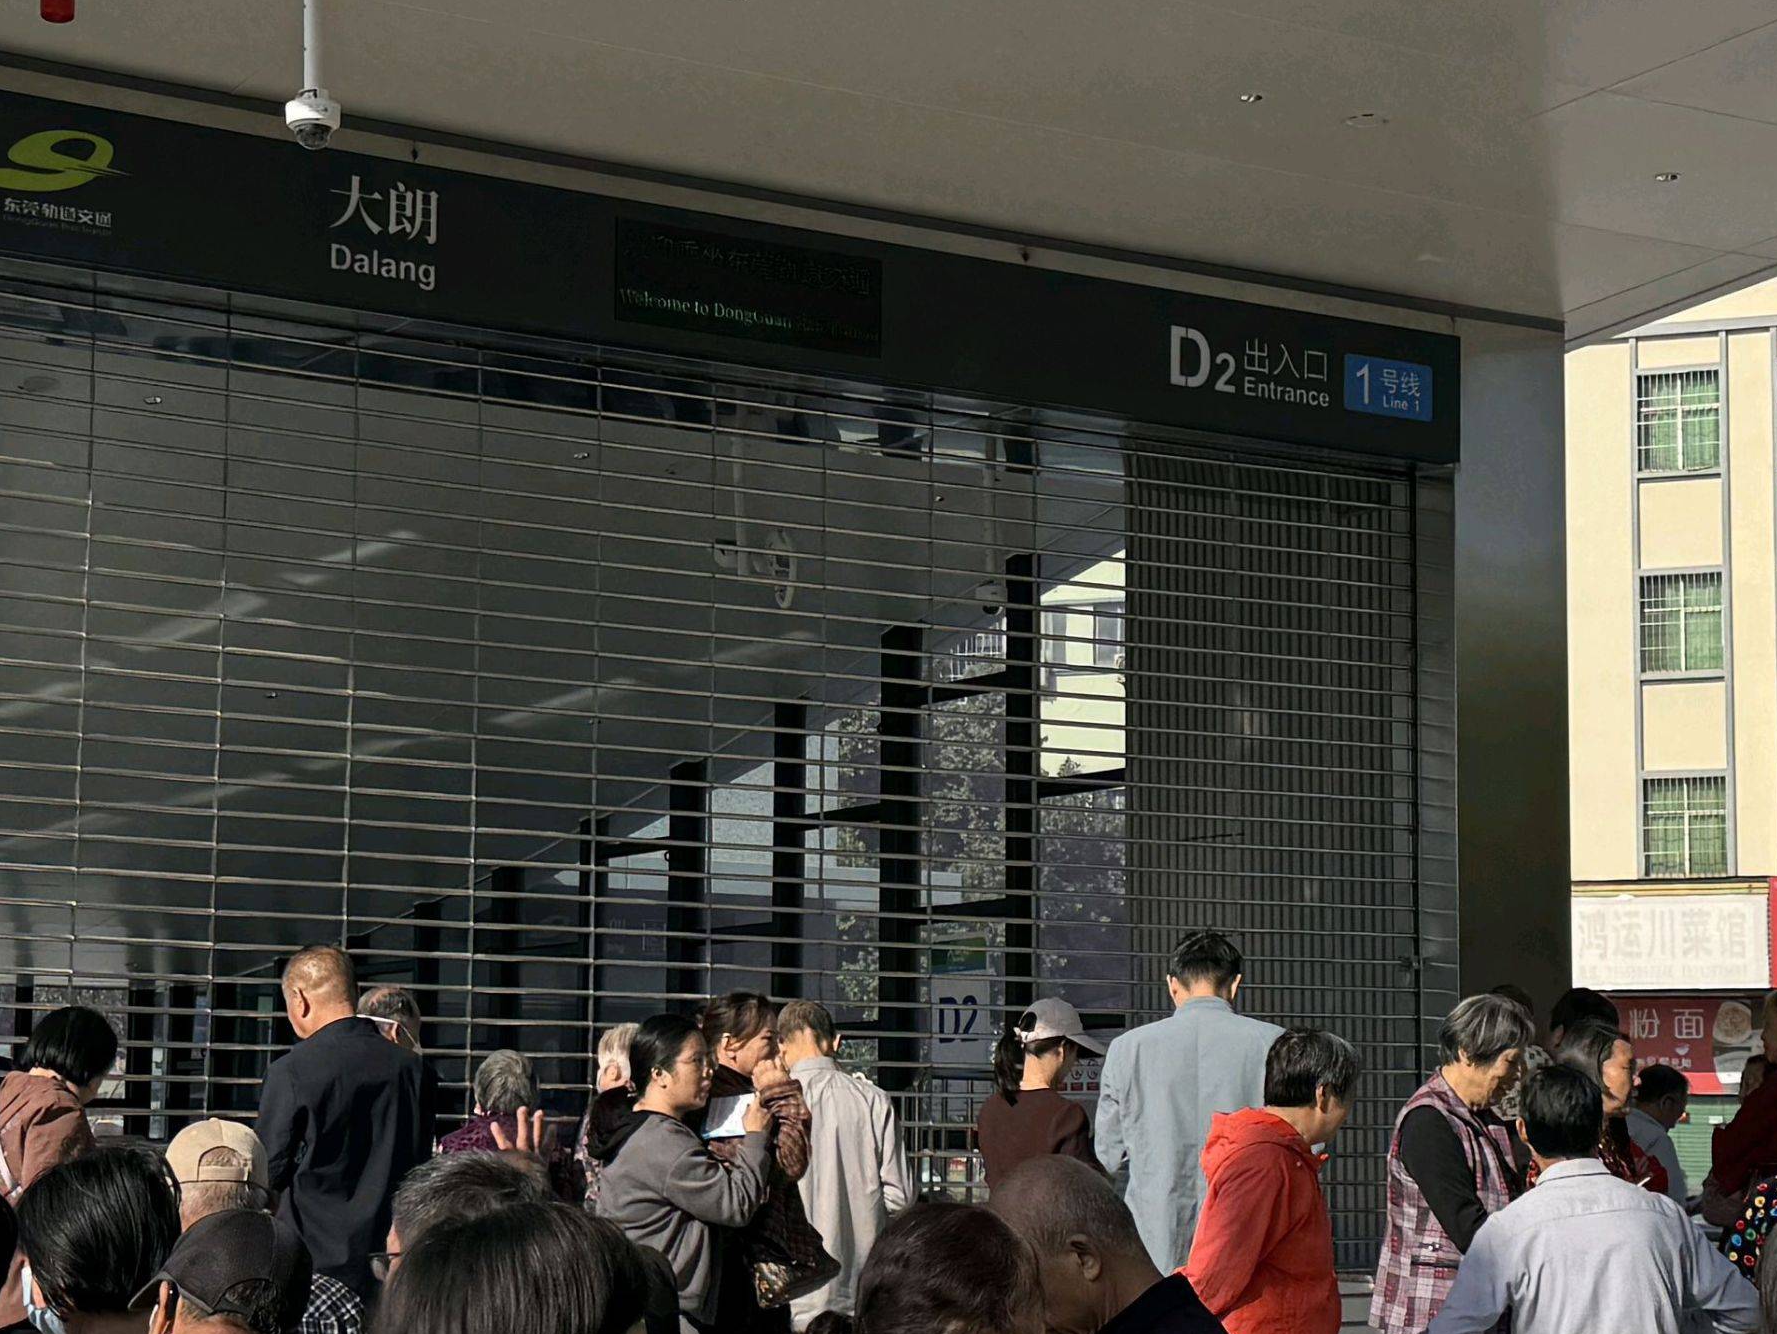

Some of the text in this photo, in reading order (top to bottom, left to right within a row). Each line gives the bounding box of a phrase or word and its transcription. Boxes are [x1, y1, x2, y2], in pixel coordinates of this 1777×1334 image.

[4, 197, 113, 228] 东莞轨道交通
[329, 174, 439, 246] 大朗
[329, 243, 437, 291] Dalang
[1170, 324, 1236, 394] D2
[1243, 337, 1329, 383] 出入口
[1243, 375, 1331, 408] Entrance
[1382, 394, 1421, 412] Line 1
[1629, 1008, 1704, 1040] 粉面
